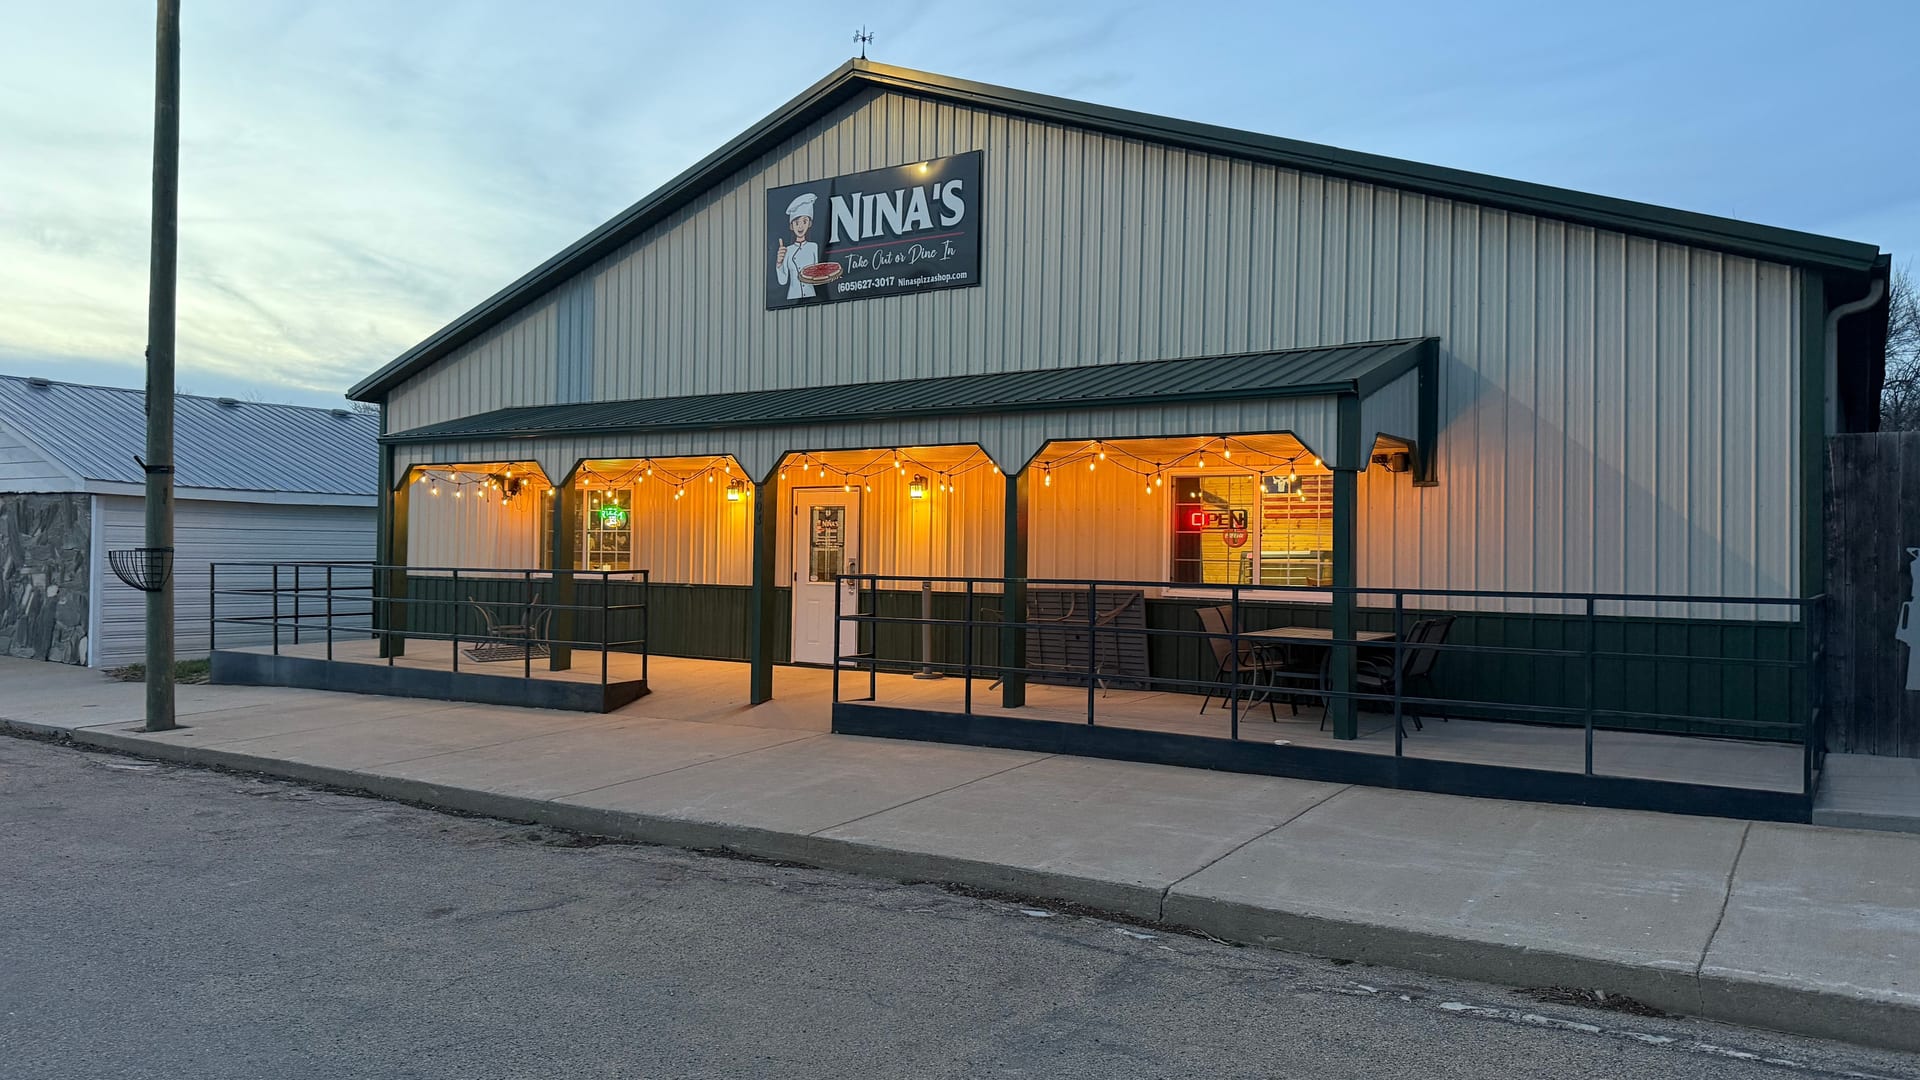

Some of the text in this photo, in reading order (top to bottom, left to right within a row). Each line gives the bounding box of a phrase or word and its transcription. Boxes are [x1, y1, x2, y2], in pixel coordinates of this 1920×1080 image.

[829, 180, 965, 243] NINA'S
[845, 240, 956, 273] Take Out or Dine In
[837, 272, 967, 293] (605)627-3017 Ninaspizzashop.com
[1191, 512, 1244, 526] OPEN
